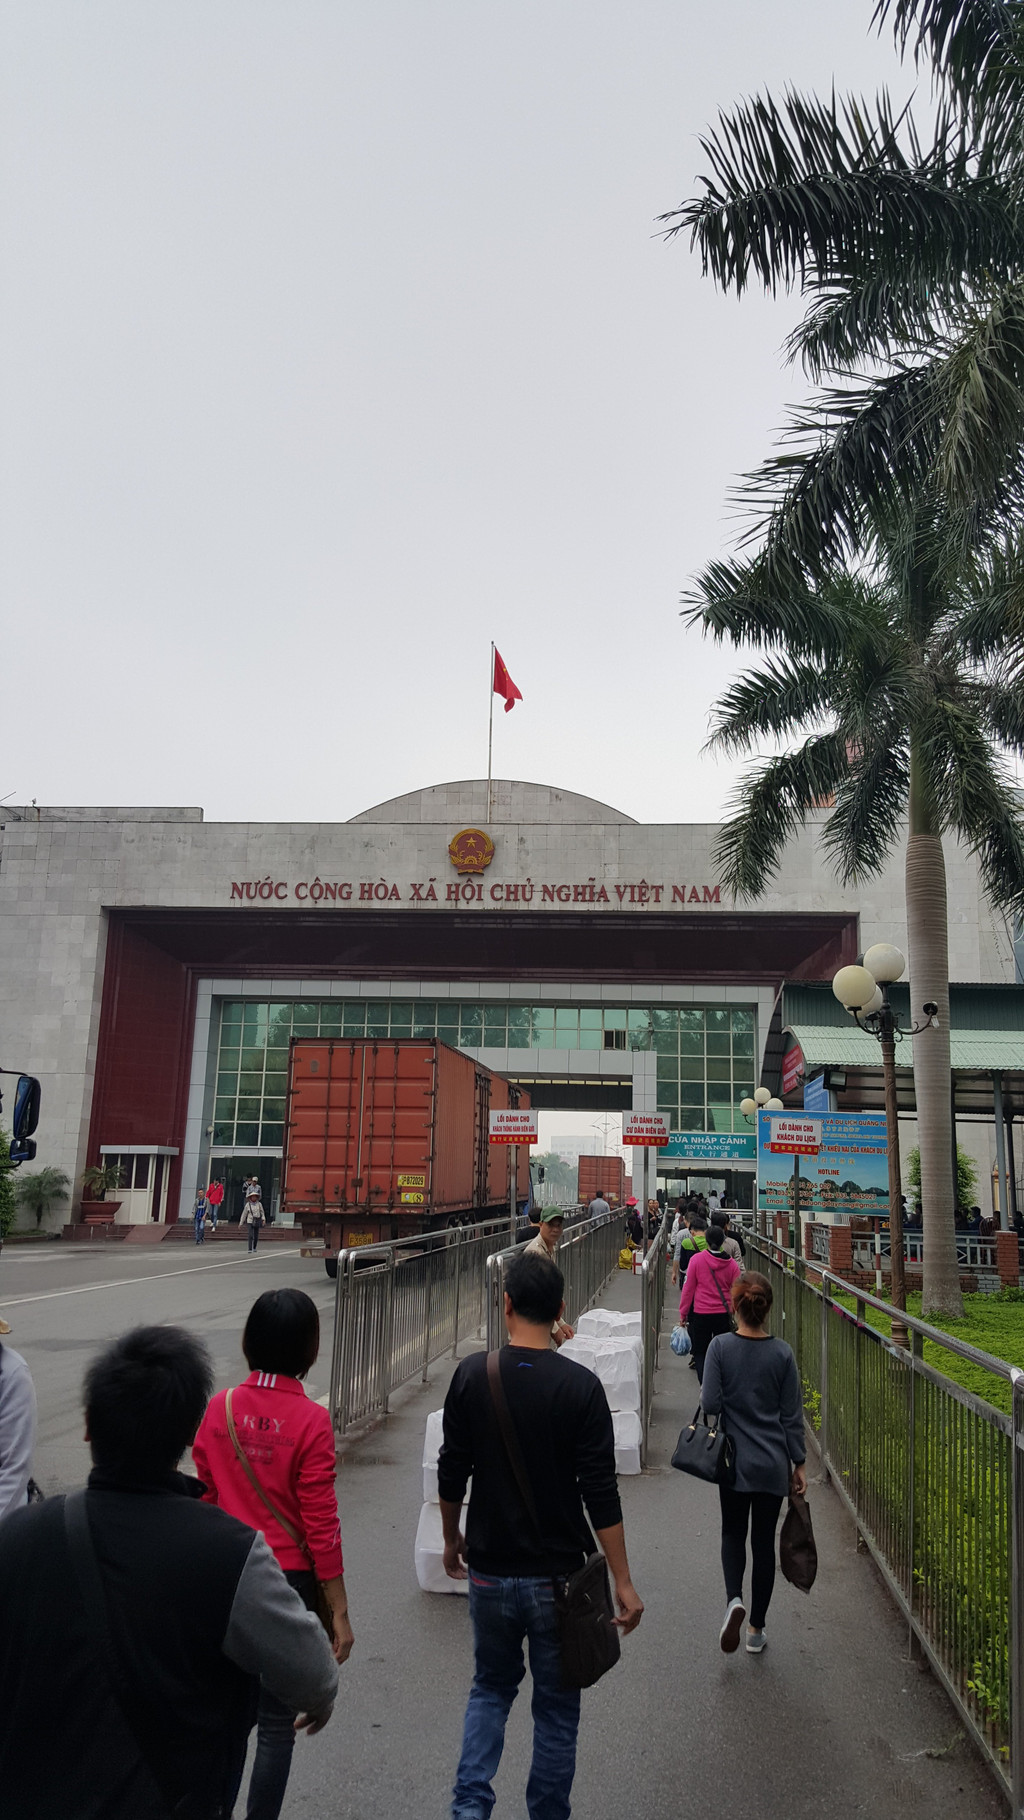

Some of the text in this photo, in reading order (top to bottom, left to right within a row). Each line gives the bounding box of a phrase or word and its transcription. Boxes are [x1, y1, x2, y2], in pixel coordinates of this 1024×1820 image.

[229, 876, 722, 907] NƯỚC CỘNG HÒA XÃ HỘI CHỦ NGHĨA VIỆT NAM
[653, 1117, 663, 1125] CHO
[858, 1118, 879, 1126] QUẢNG
[634, 1126, 644, 1134] DÂN
[779, 1121, 787, 1131] LỐI
[788, 1123, 802, 1131] DÀNH
[803, 1125, 813, 1133] CHO
[668, 1134, 688, 1143] CỬA
[691, 1135, 717, 1145] NHẬP
[719, 1135, 747, 1145] CẢNH
[777, 1132, 794, 1141] KHÁCH
[796, 1134, 803, 1142] DU
[804, 1135, 816, 1144] LỊCH
[817, 1168, 840, 1176] HOTLINE
